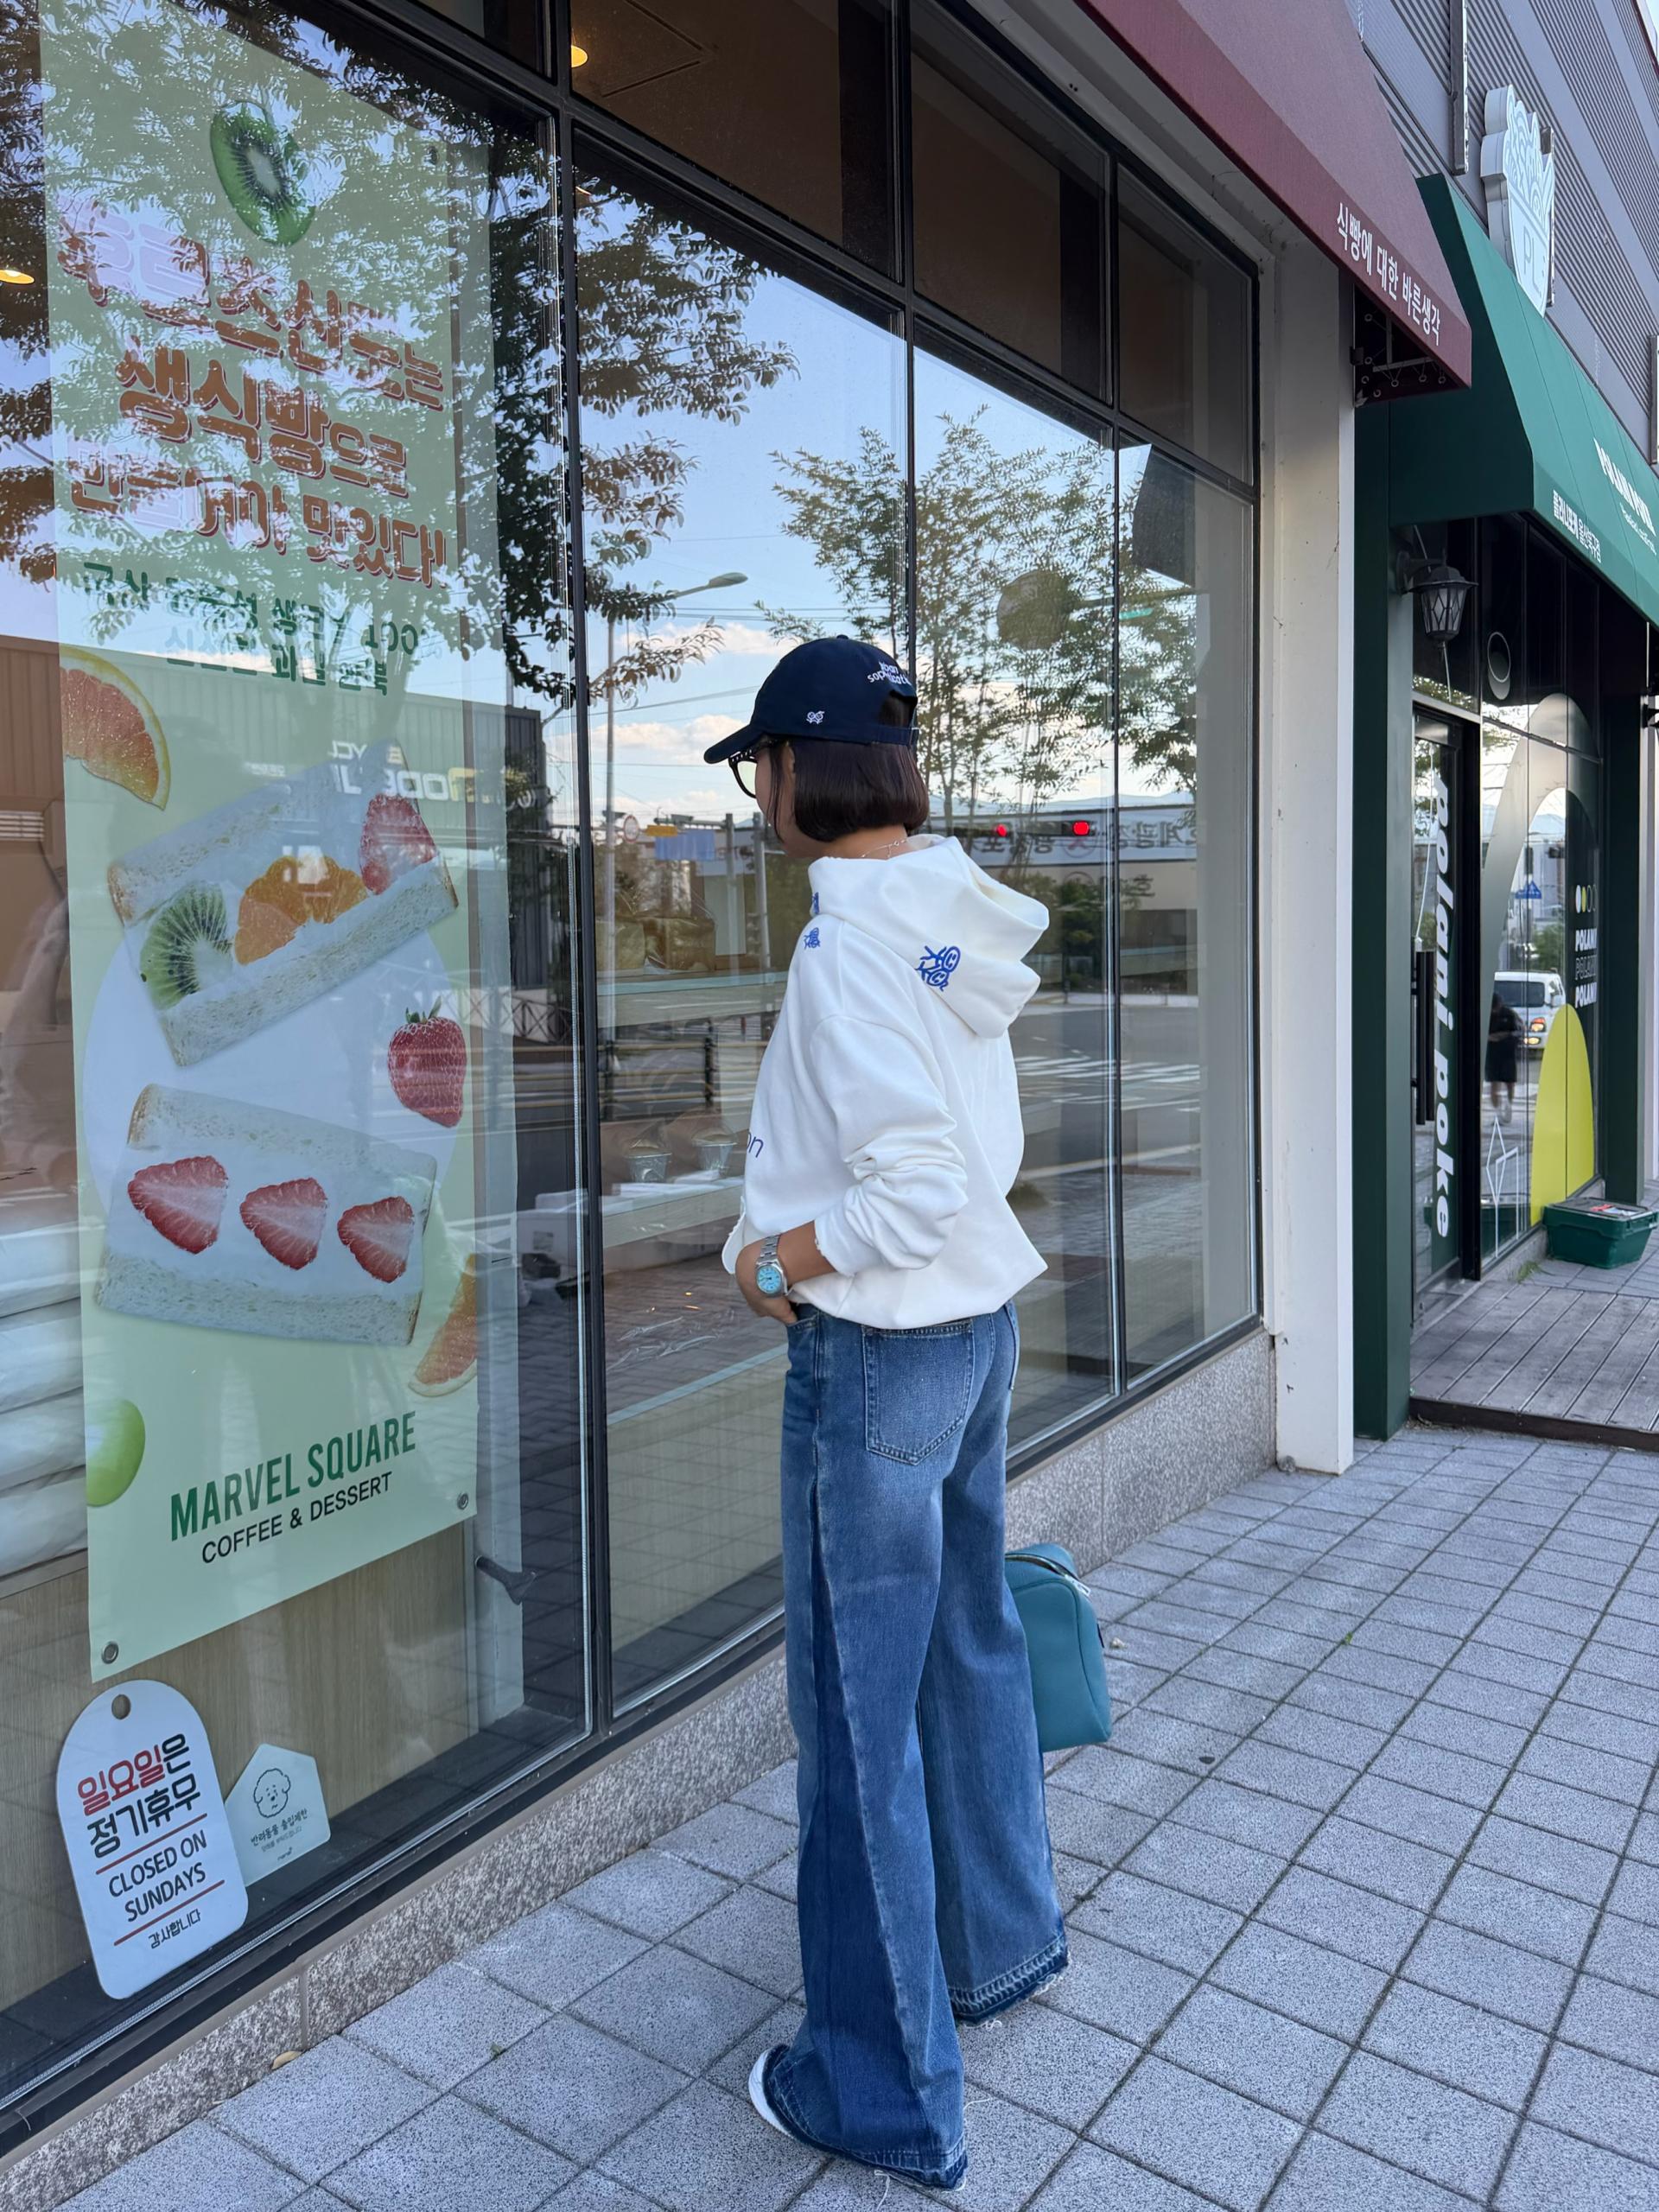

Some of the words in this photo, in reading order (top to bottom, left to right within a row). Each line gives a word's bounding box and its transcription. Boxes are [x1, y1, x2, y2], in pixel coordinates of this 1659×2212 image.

[1337, 202, 1373, 276] 식빵에
[1376, 245, 1399, 302] 대한
[1402, 271, 1440, 346] 바른생각
[114, 333, 410, 499] 생식빵으로
[67, 434, 292, 556] 만들어야
[302, 494, 449, 589] 맛있다!
[1434, 769, 1453, 1030] polani
[1434, 1047, 1454, 1237] poke
[170, 1452, 300, 1542] MARVEL
[307, 1410, 416, 1488] SQUARE
[201, 1514, 283, 1564] COFFEE
[289, 1507, 302, 1529] &
[310, 1471, 392, 1522] DESSERT
[78, 1733, 191, 1816] 일요일은
[87, 1773, 200, 1859] 정기휴무
[109, 1846, 177, 1897] CLOSED
[180, 1829, 207, 1859] ON
[124, 1862, 206, 1923] SUNDAYS
[149, 1908, 201, 1949] 감사합니다
